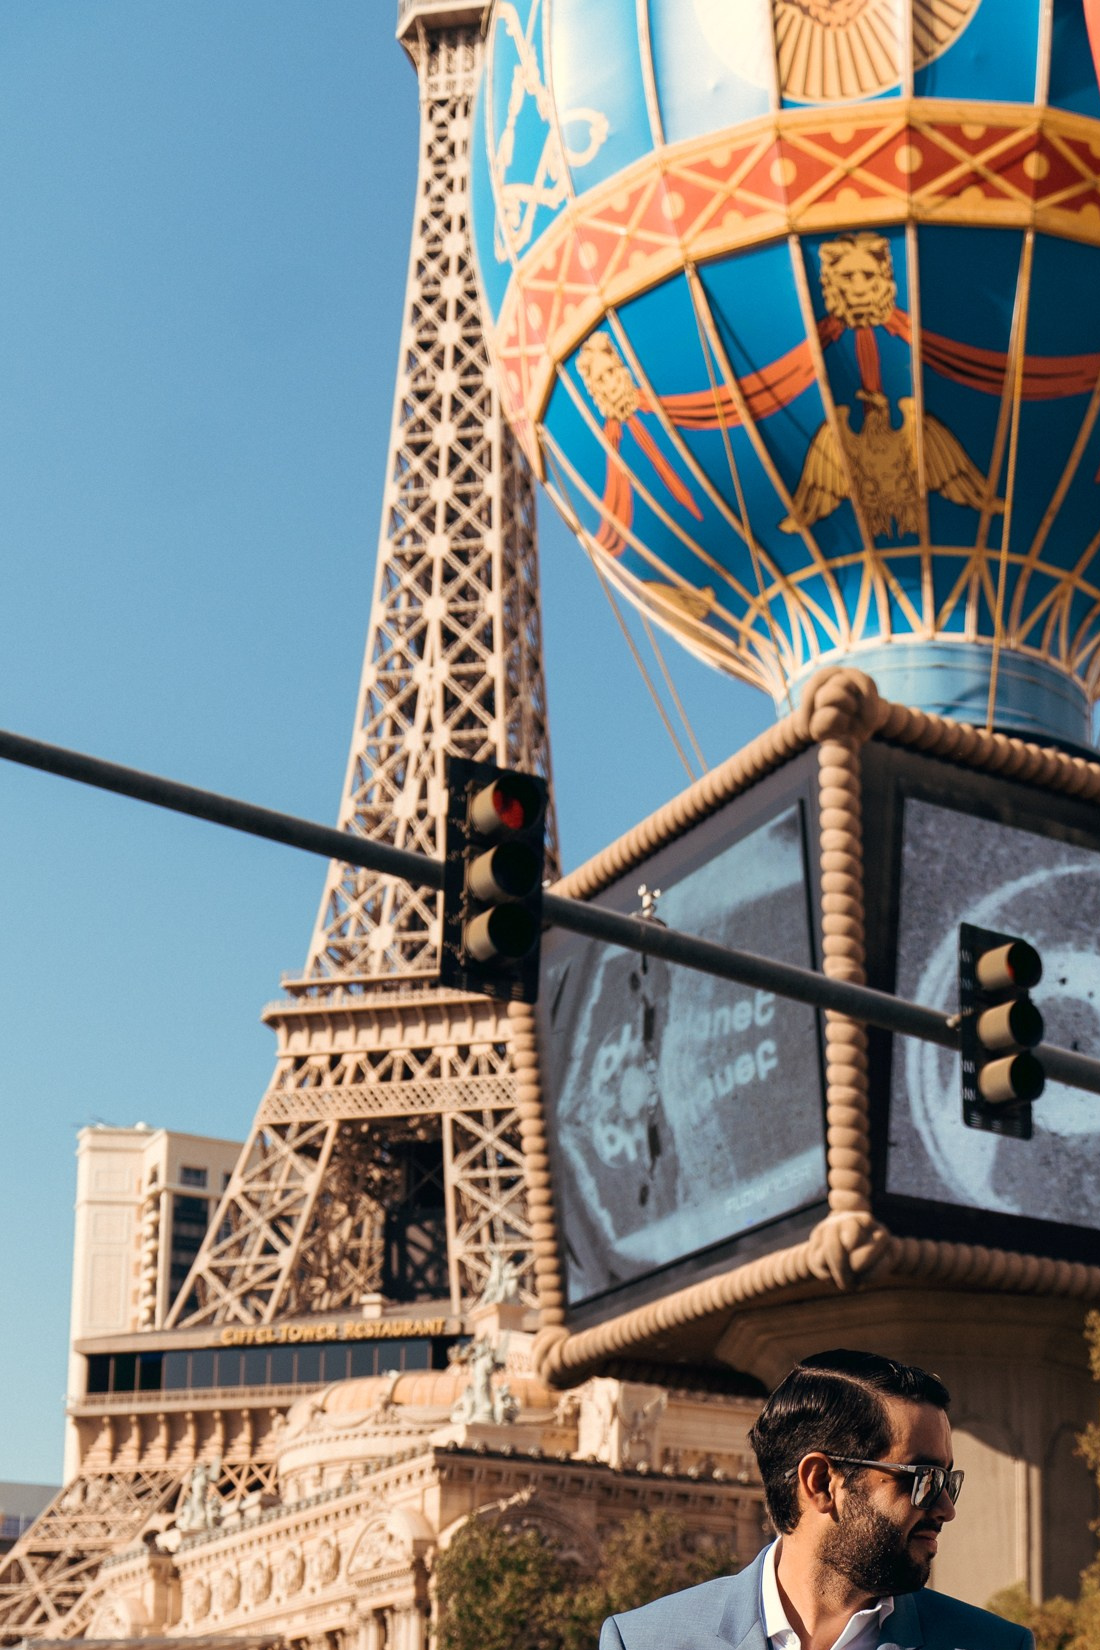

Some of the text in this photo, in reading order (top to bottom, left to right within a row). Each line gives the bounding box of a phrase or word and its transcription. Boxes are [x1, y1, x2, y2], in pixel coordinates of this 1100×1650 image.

[220, 1317, 445, 1346] EIFFEL TOWER RESTAURANT
